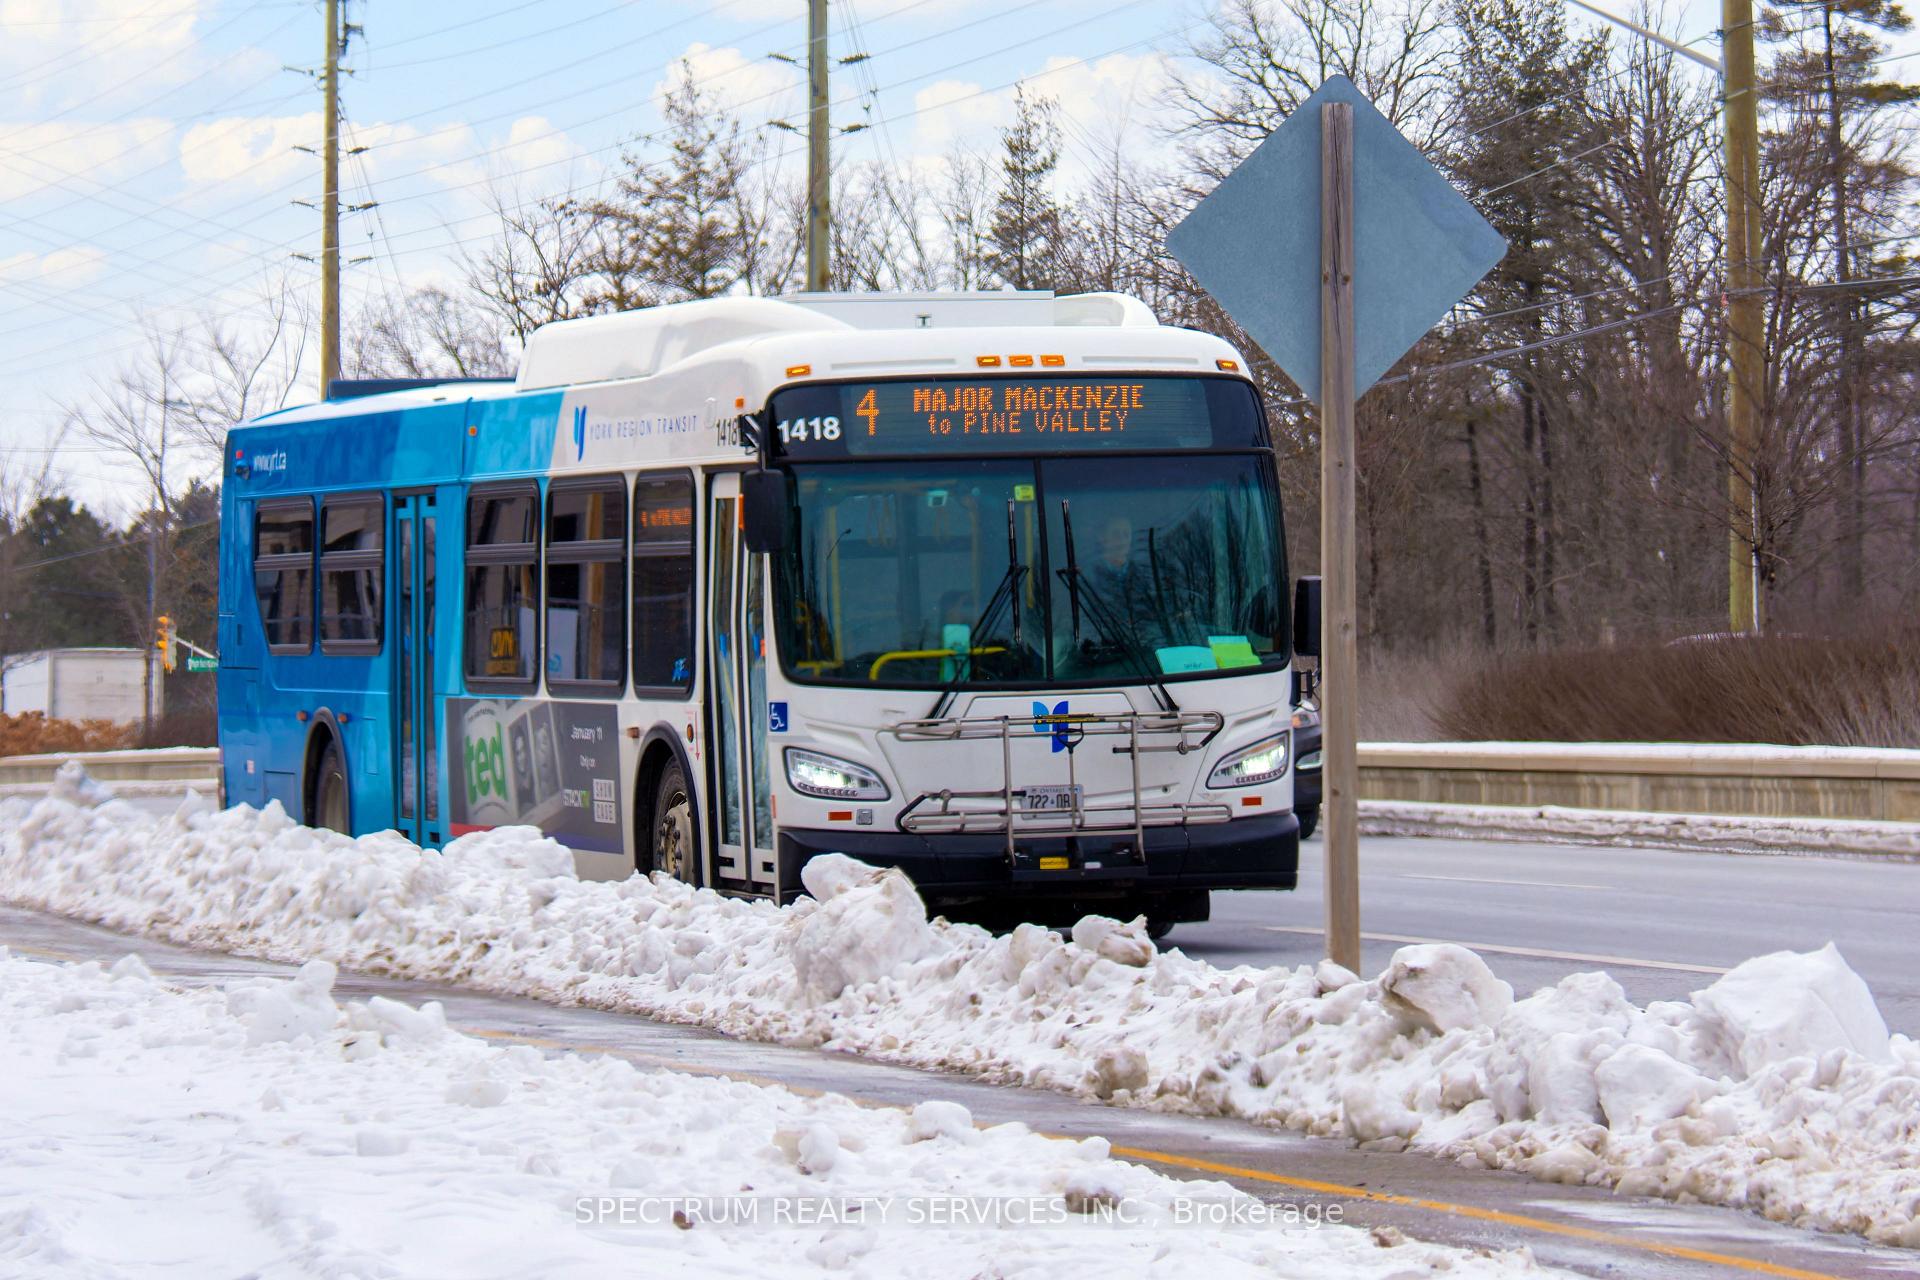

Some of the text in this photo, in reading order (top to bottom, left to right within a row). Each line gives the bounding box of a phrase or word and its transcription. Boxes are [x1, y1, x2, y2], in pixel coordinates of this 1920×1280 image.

[856, 388, 880, 436] 4
[913, 385, 1144, 412] MAJOR MACKENZIE
[590, 415, 697, 440] YORK REGION TRANSIT
[716, 418, 738, 446] 1418
[777, 416, 841, 443] 1418
[928, 410, 1128, 435] to PINE VALLEY
[464, 721, 508, 806] ted
